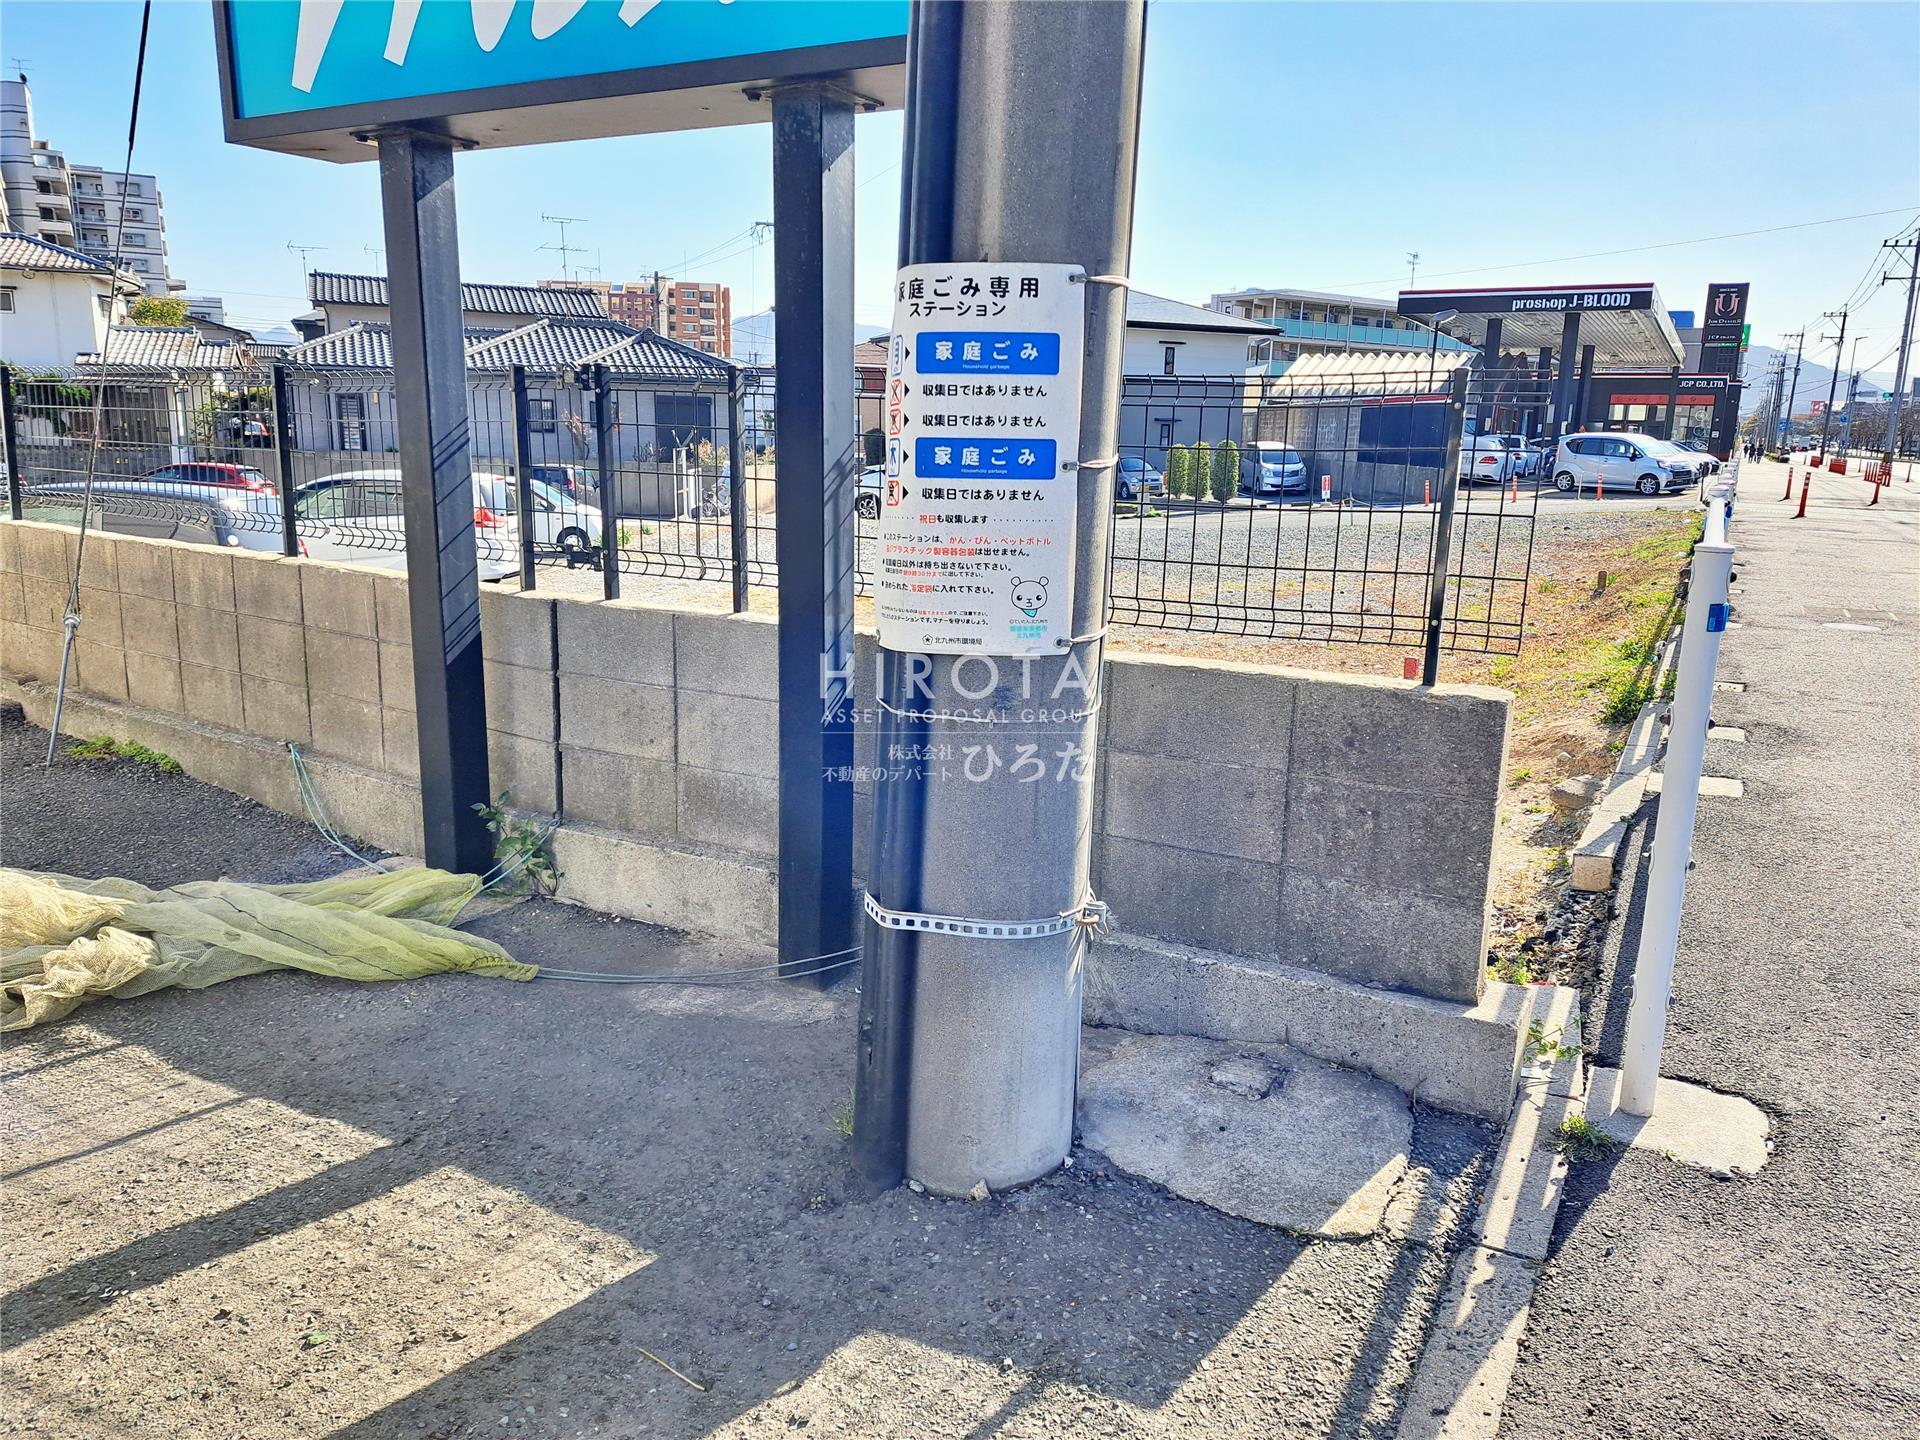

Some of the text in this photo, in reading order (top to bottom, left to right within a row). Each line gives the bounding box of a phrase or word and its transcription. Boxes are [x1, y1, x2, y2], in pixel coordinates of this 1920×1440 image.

[1512, 293, 1631, 311] proshop J-BLOOD
[909, 301, 1006, 317] ステーション
[935, 340, 1039, 361] 家庭ごみ
[922, 384, 1047, 397] 収集日ではありません
[1679, 380, 1694, 388] JCP
[922, 414, 1046, 427] 収集日ではありません
[934, 446, 1036, 466] 家庭ごみ
[922, 488, 1045, 500] 収集日ではありません
[919, 514, 988, 524] 祝日も収集します
